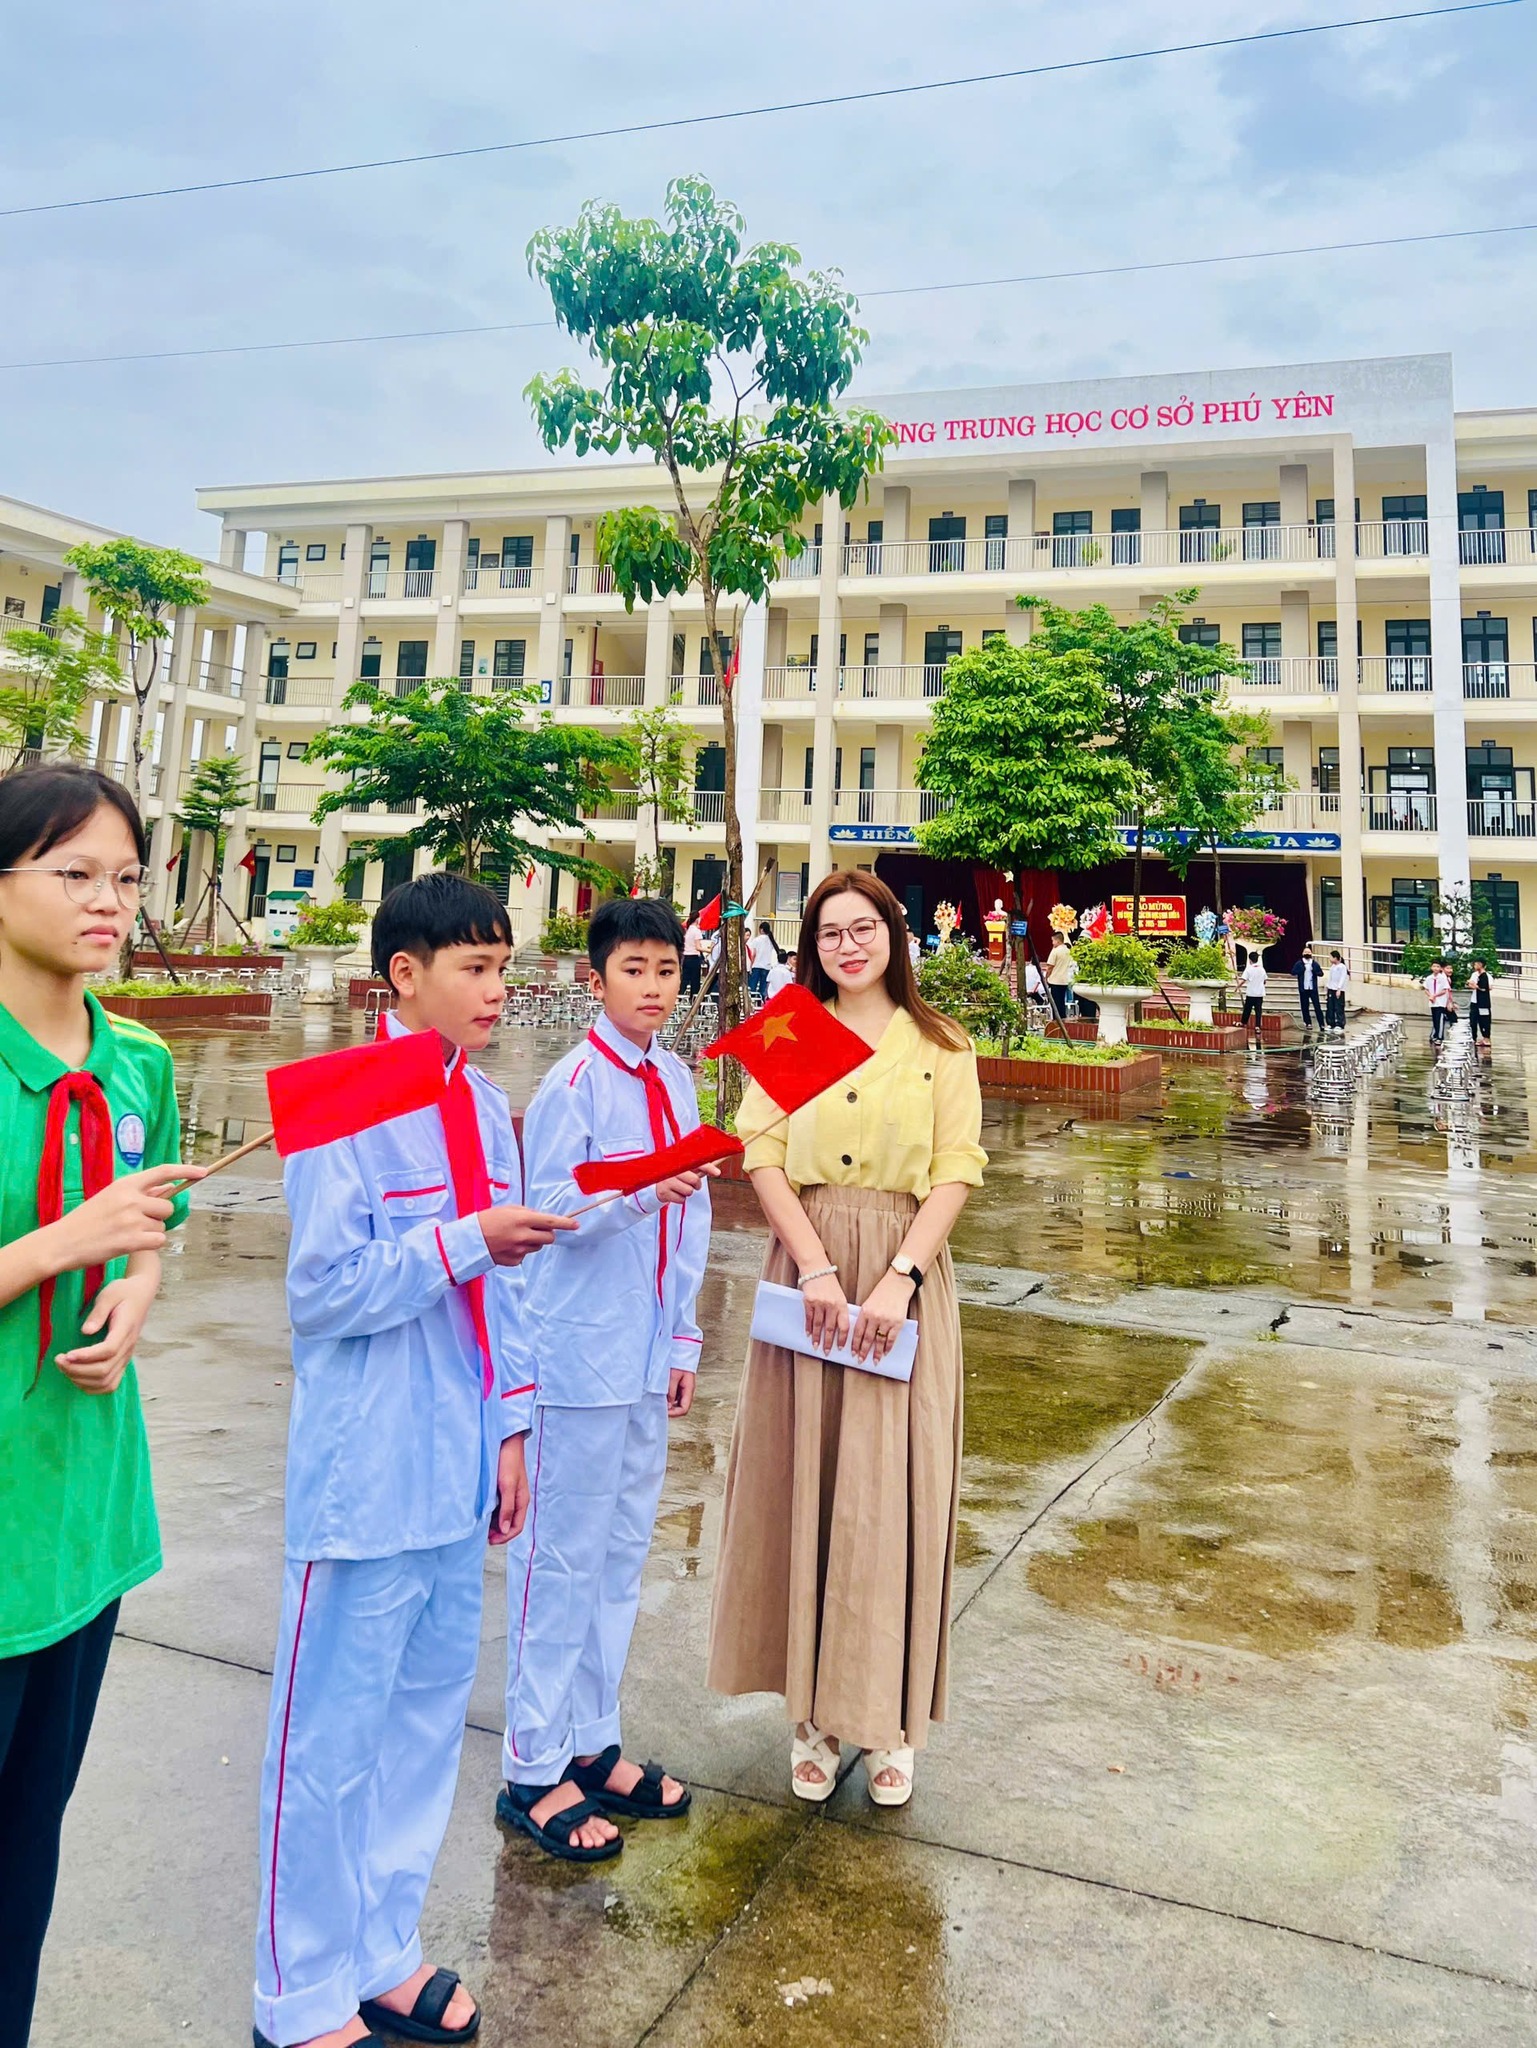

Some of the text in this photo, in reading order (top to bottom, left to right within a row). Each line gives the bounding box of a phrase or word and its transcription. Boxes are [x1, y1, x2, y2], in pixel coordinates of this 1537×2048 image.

[944, 415, 1036, 441] TRUNG
[1045, 410, 1102, 438] HỌC
[1110, 404, 1149, 430] CƠ
[1157, 395, 1194, 427] SỞ
[1202, 392, 1262, 424] PHÚ
[1271, 390, 1335, 419] YÊN
[861, 826, 910, 840] HIỀN
